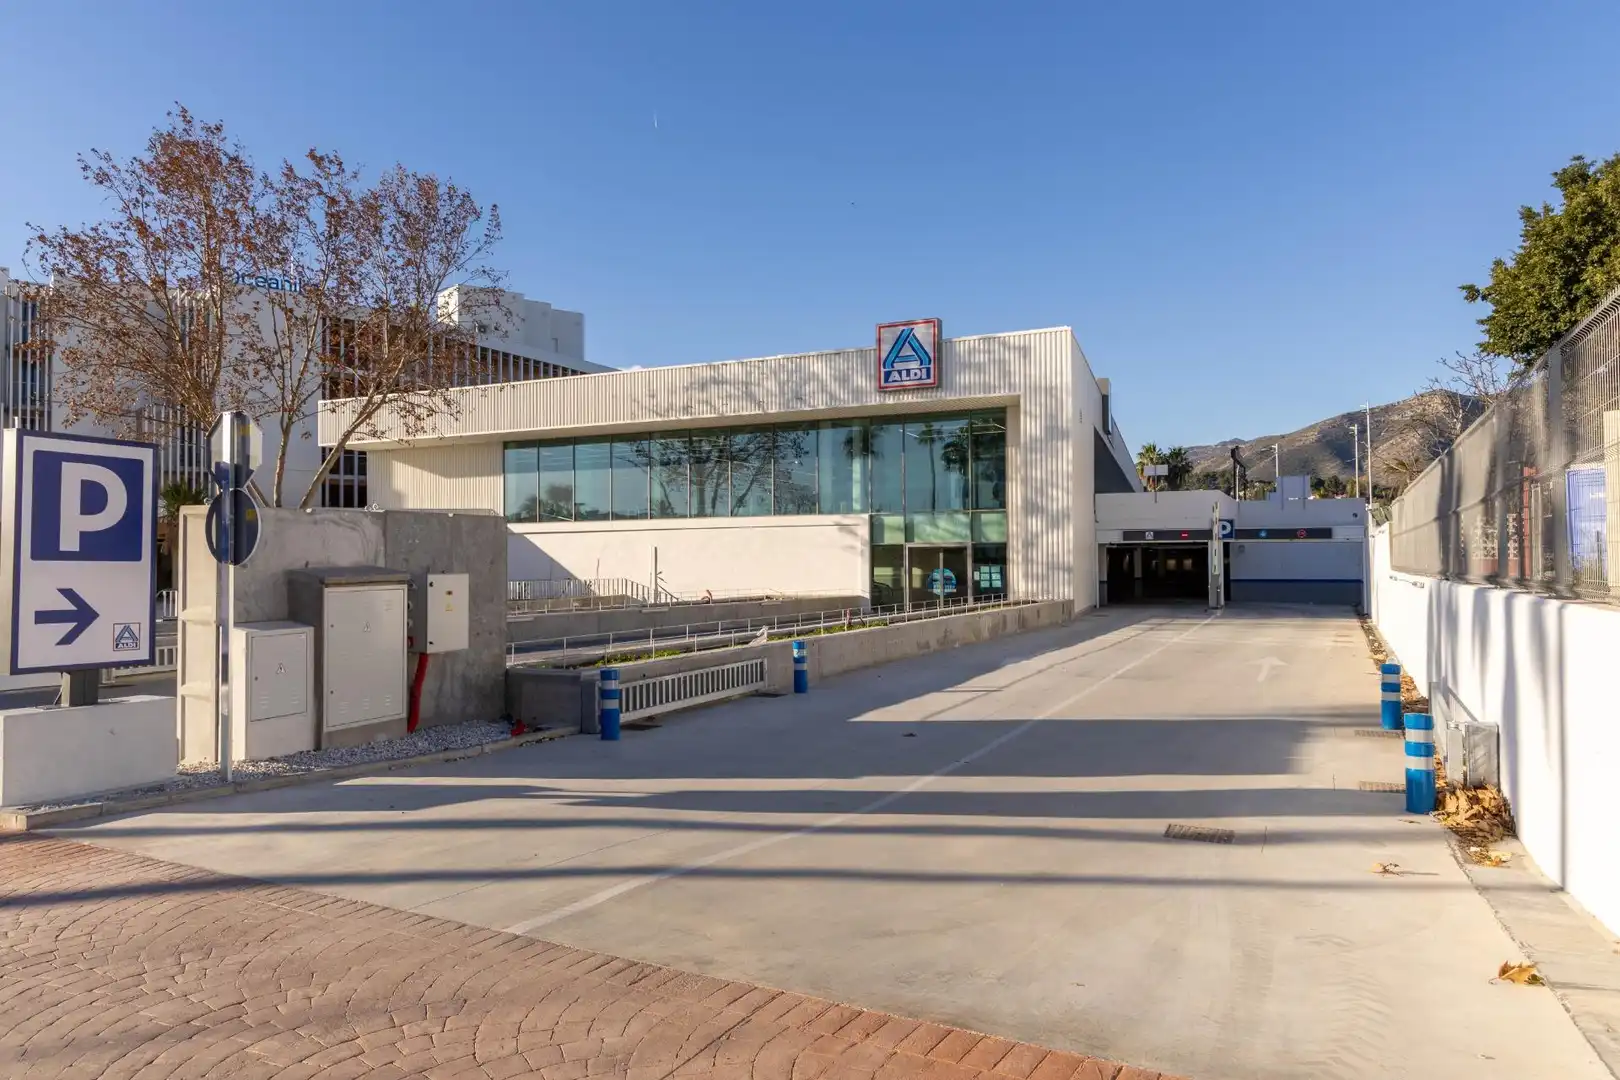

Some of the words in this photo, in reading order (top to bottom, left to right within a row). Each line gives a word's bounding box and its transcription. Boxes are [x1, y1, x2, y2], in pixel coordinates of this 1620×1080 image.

[888, 368, 927, 382] ALDI
[59, 461, 128, 552] P
[1218, 521, 1232, 539] P
